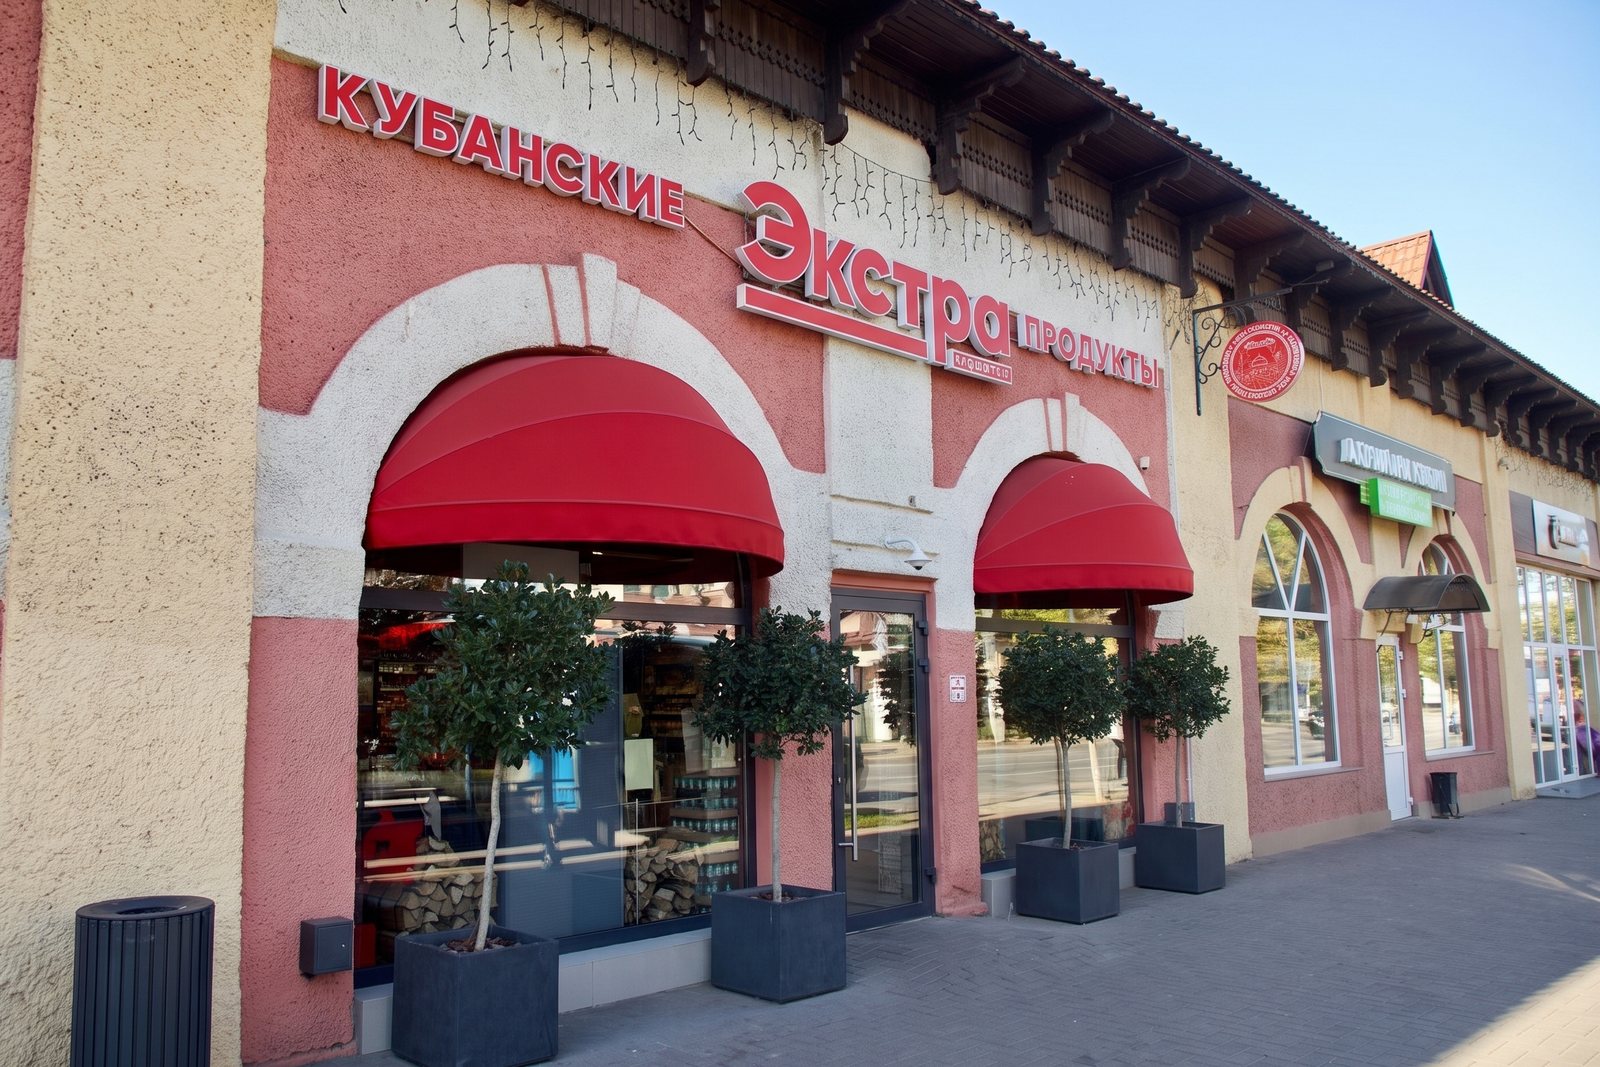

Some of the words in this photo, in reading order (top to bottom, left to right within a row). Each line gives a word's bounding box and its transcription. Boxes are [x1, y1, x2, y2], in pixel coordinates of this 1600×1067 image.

[320, 65, 684, 229] КУБАНСКИЕ
[737, 181, 1011, 365] Экстра
[1022, 314, 1158, 388] ПРОДУКТЫ
